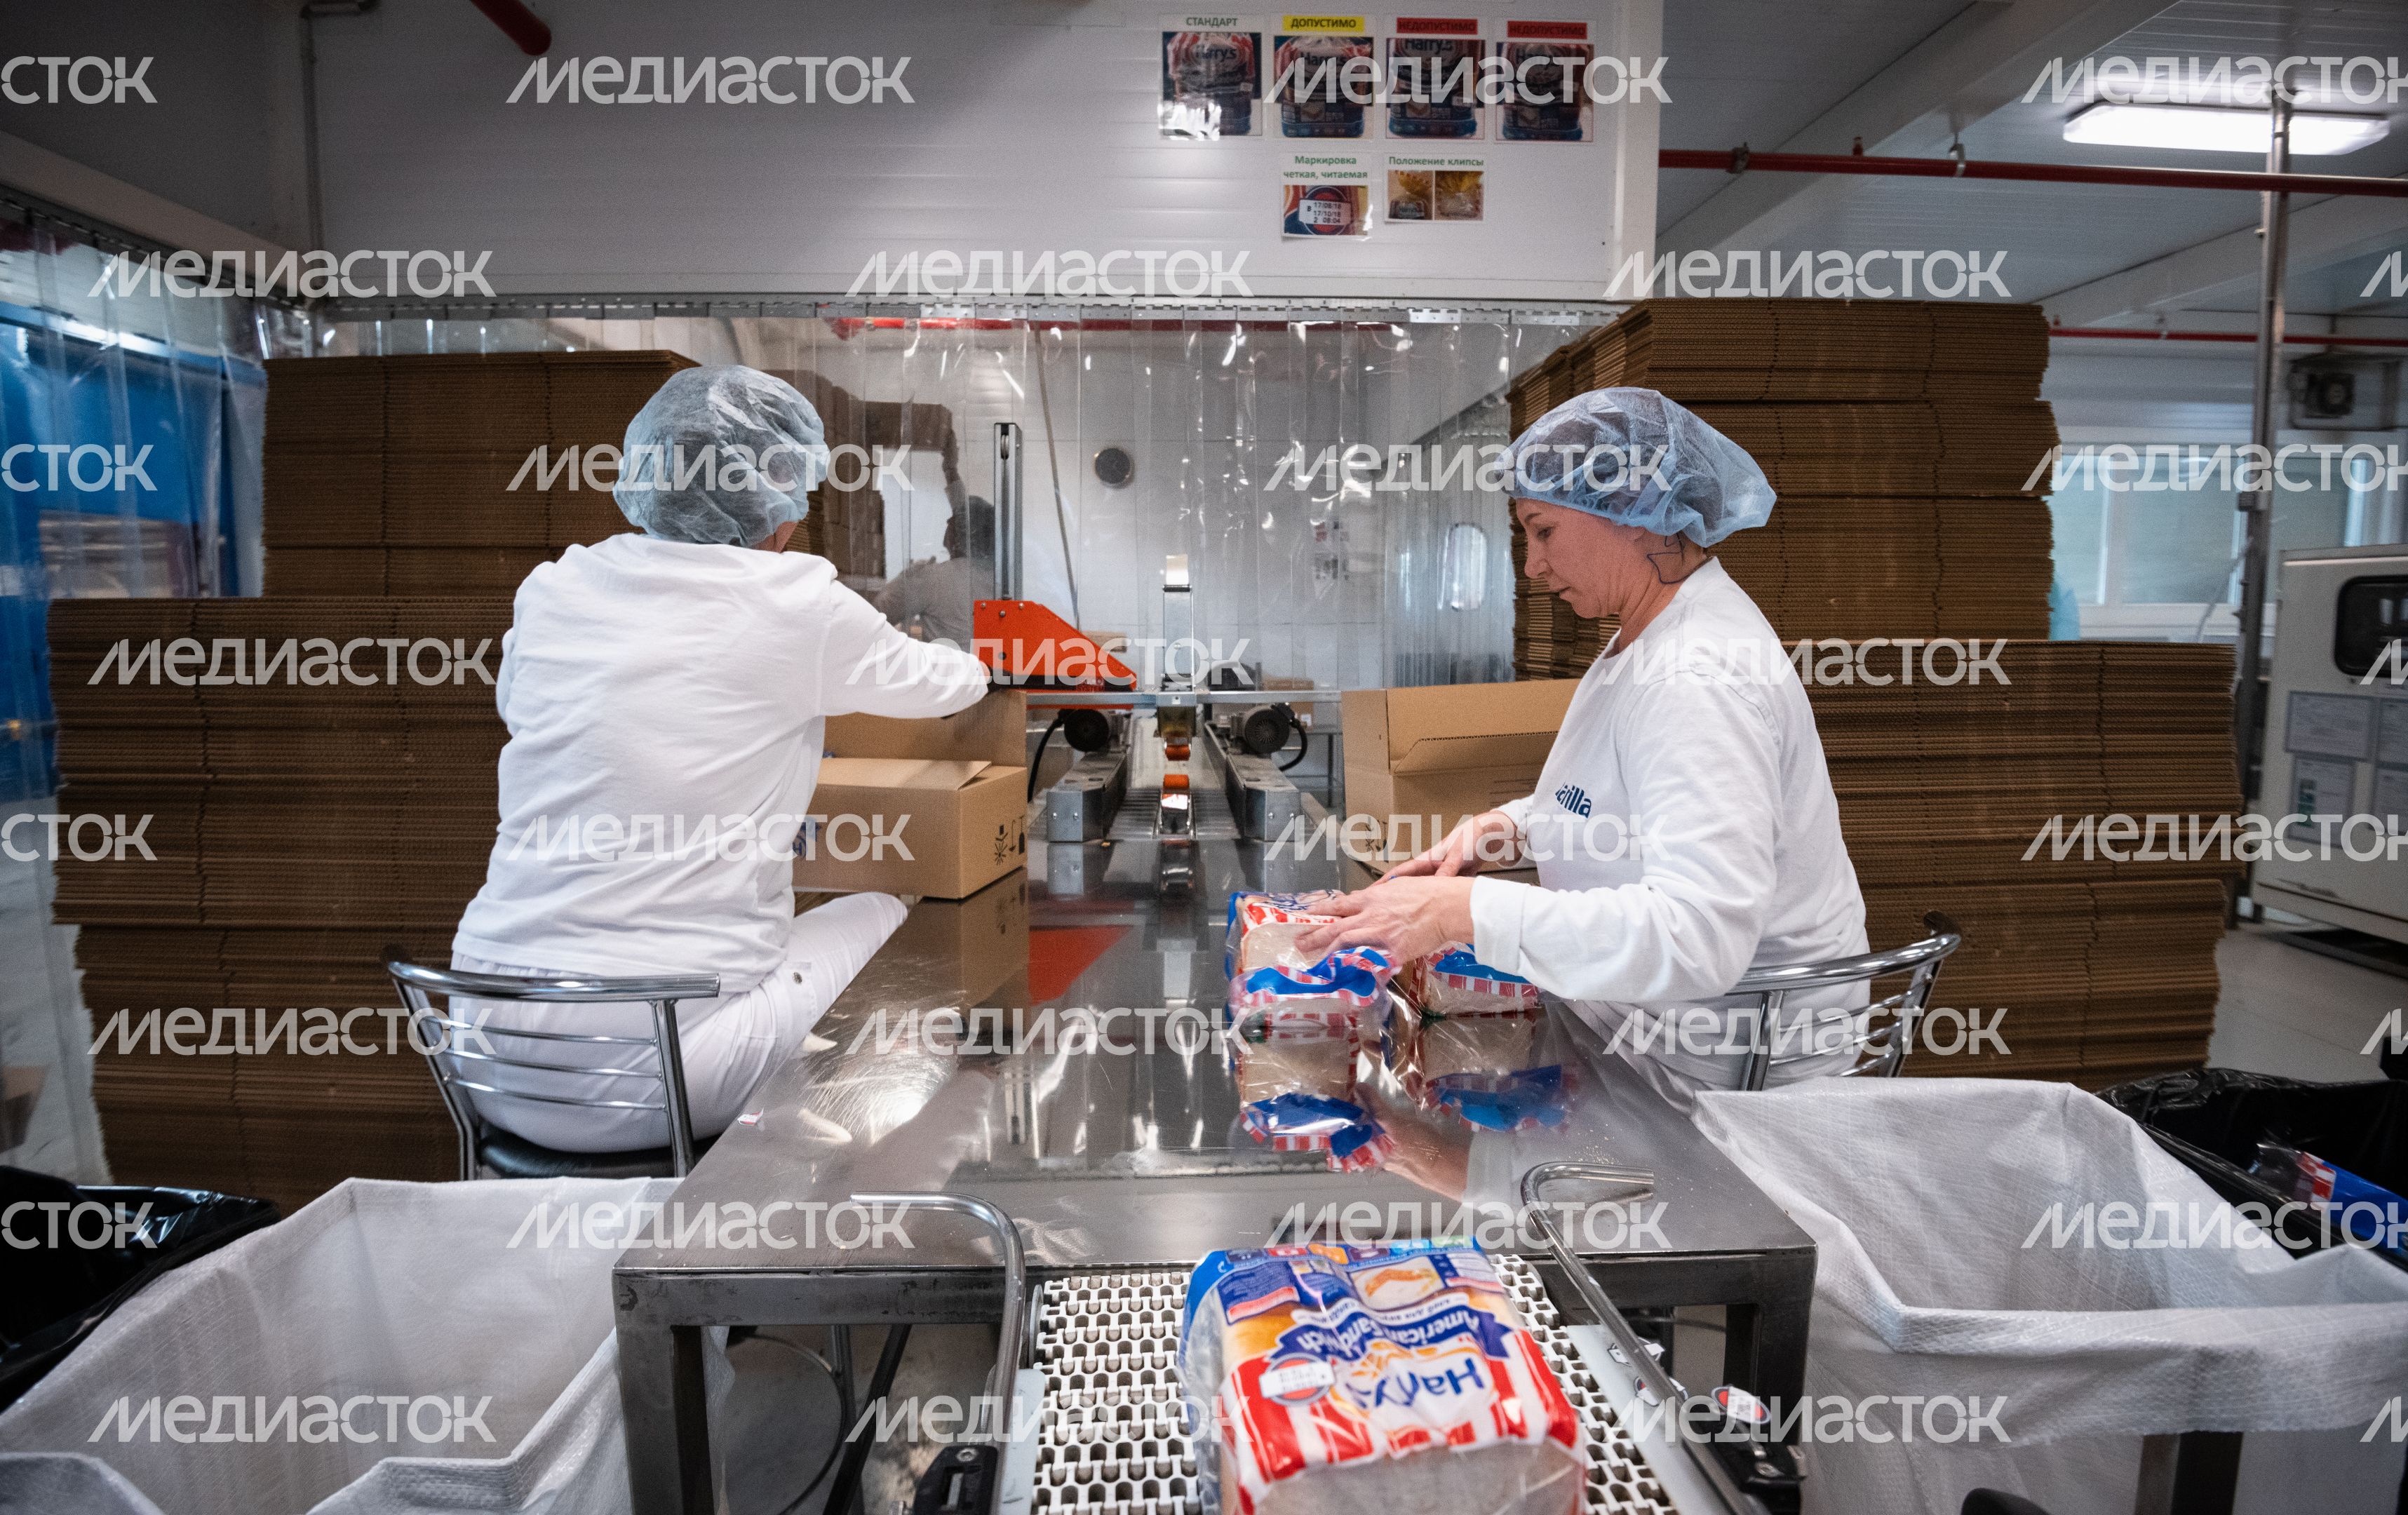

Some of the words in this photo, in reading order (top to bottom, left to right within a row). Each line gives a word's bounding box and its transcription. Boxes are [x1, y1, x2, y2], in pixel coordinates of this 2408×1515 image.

[1185, 18, 1238, 27] СТАНДАРТ
[1291, 18, 1357, 28] ДОПУСТИМО
[1398, 21, 1476, 32] НЕДОПУСТИМО
[1508, 25, 1585, 36] НЕДОПУСТИМО
[1295, 156, 1357, 166] Маркировка
[1389, 156, 1445, 166] Положение
[1284, 171, 1319, 180] четкая,
